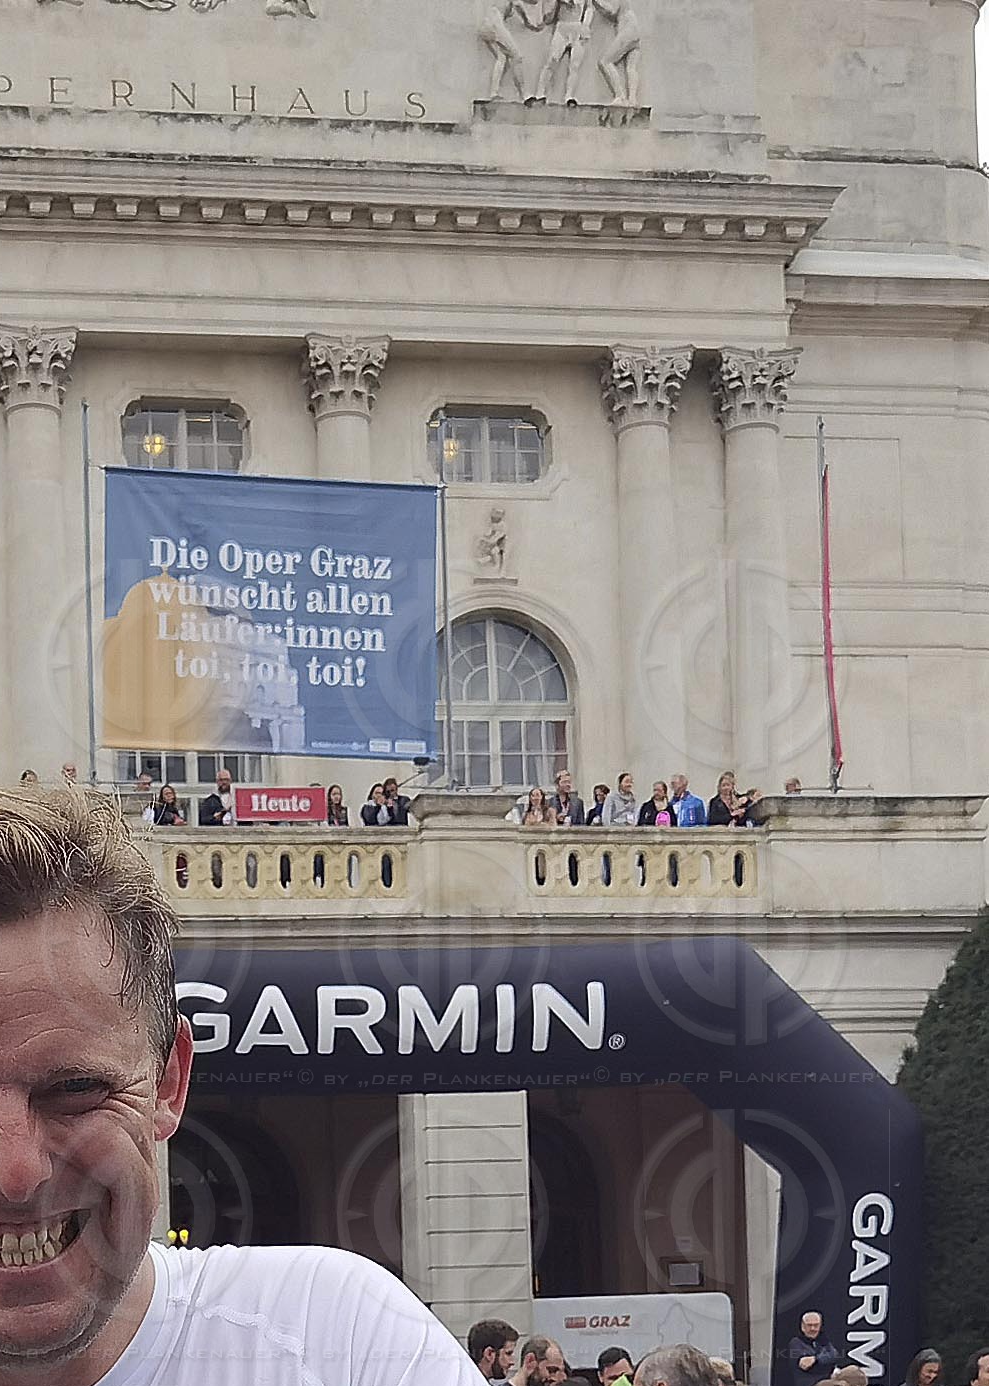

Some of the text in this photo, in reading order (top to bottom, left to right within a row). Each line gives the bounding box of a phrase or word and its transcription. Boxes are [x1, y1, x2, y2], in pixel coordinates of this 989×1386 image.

[149, 536, 392, 581] Die Oper Graz
[147, 576, 393, 616] wünscht allen
[156, 612, 386, 652] Läufer:innen
[174, 650, 367, 688] toi, toi, toi!
[251, 793, 311, 812] Heute
[589, 1315, 631, 1328] GRAZ
